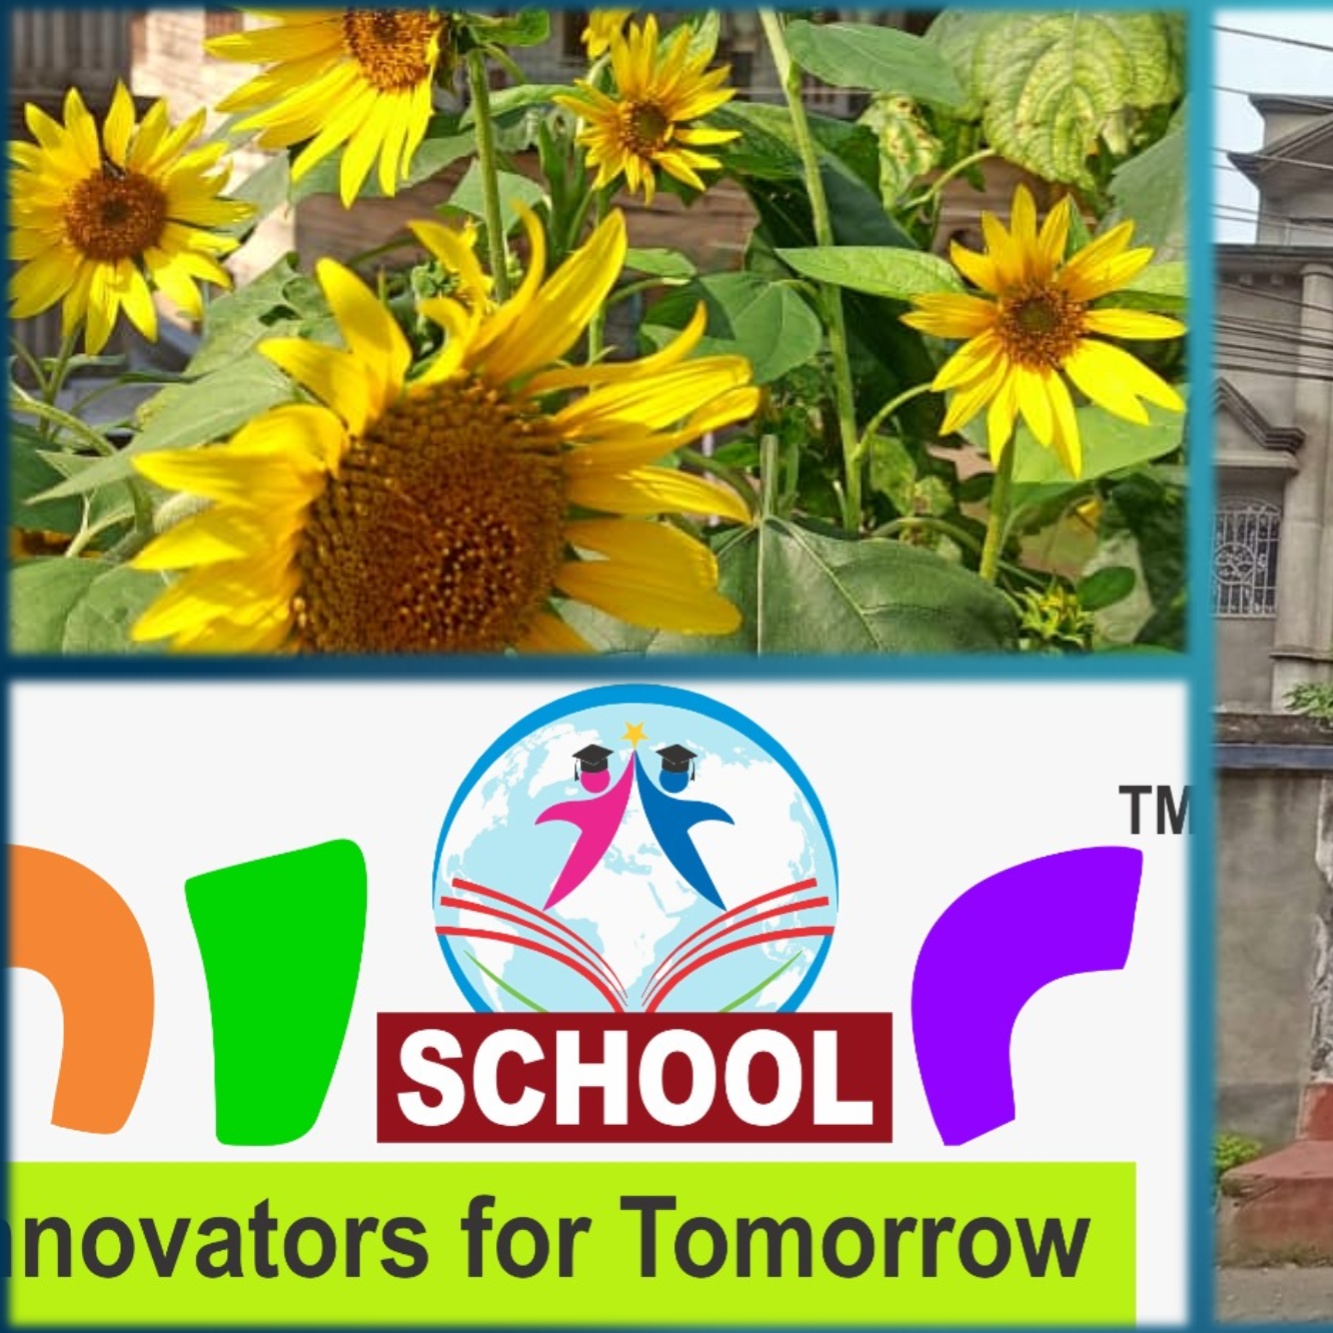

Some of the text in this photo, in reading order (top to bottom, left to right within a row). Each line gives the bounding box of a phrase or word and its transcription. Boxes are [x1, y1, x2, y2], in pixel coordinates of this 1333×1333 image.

[398, 1029, 873, 1128] SCHOOL
[461, 1195, 592, 1278] for
[620, 1197, 1092, 1279] Tomorrow
